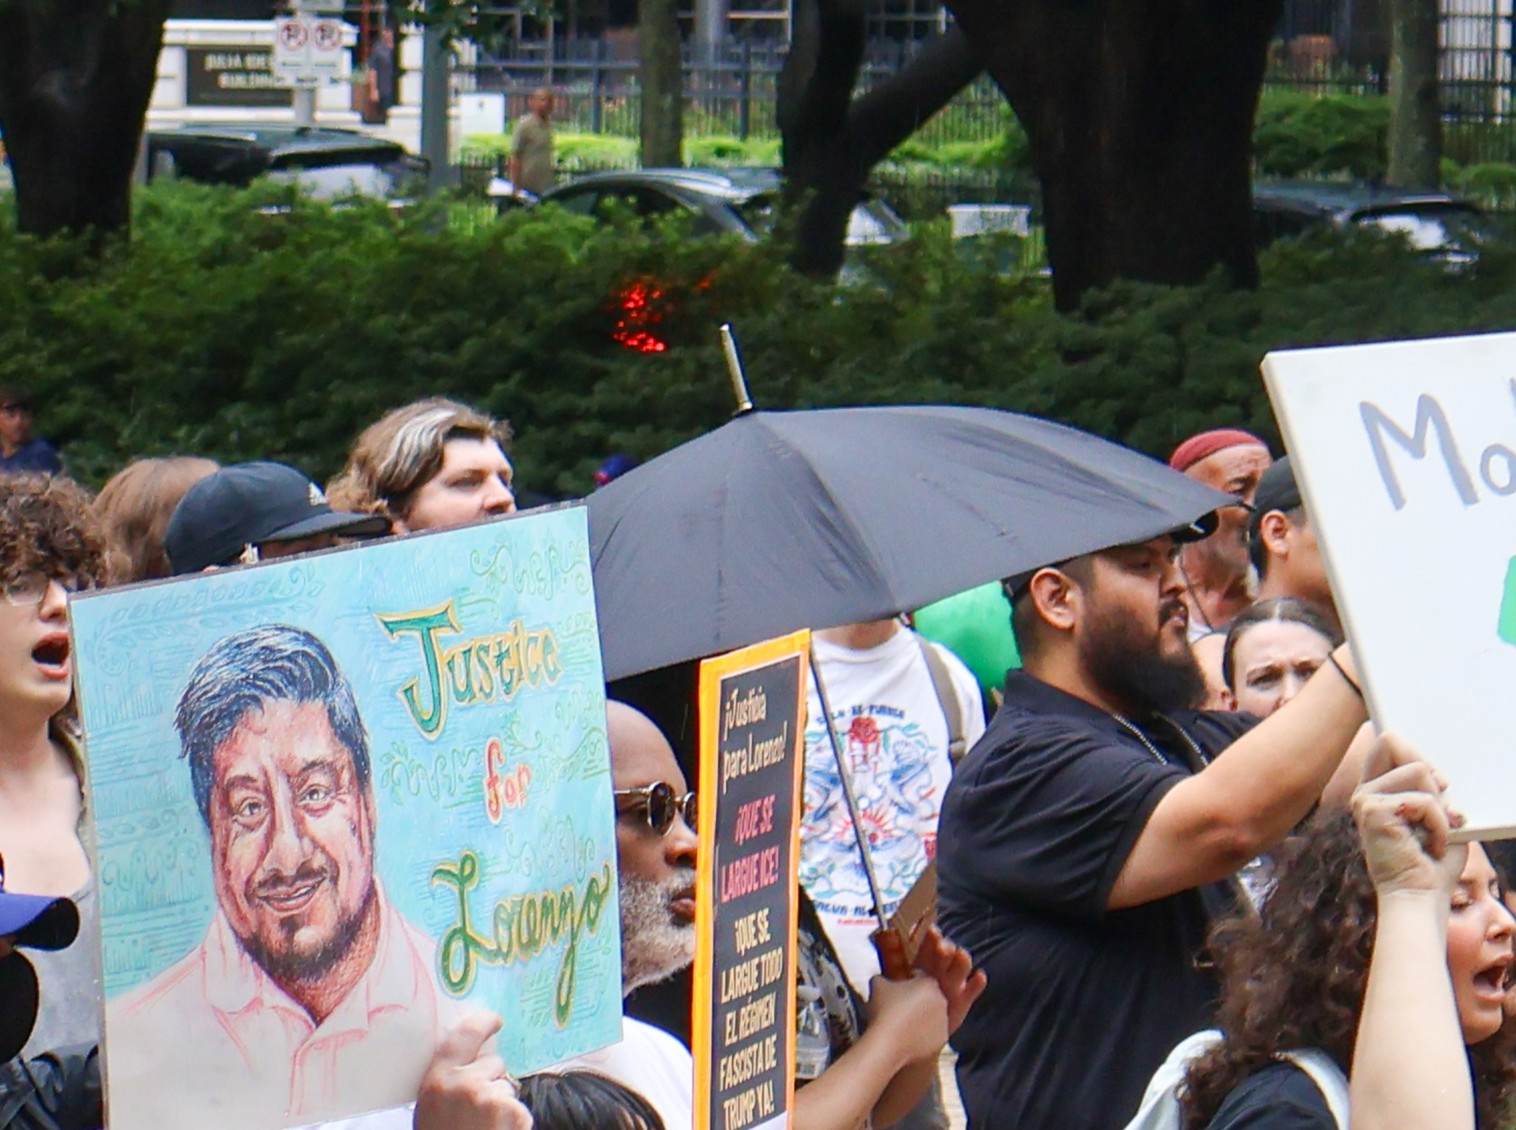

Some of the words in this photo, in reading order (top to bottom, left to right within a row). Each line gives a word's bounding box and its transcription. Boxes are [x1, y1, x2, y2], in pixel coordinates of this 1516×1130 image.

[374, 600, 564, 741] Justice
[482, 737, 534, 825] for
[432, 849, 613, 1029] Lorenzo
[758, 908, 771, 942] SE
[721, 960, 759, 1004] LARGUE
[761, 947, 783, 985] TODO
[725, 1010, 737, 1047] EL
[720, 1042, 762, 1092] FASCISTA
[764, 1037, 777, 1069] DE
[757, 1081, 775, 1117] YA!
